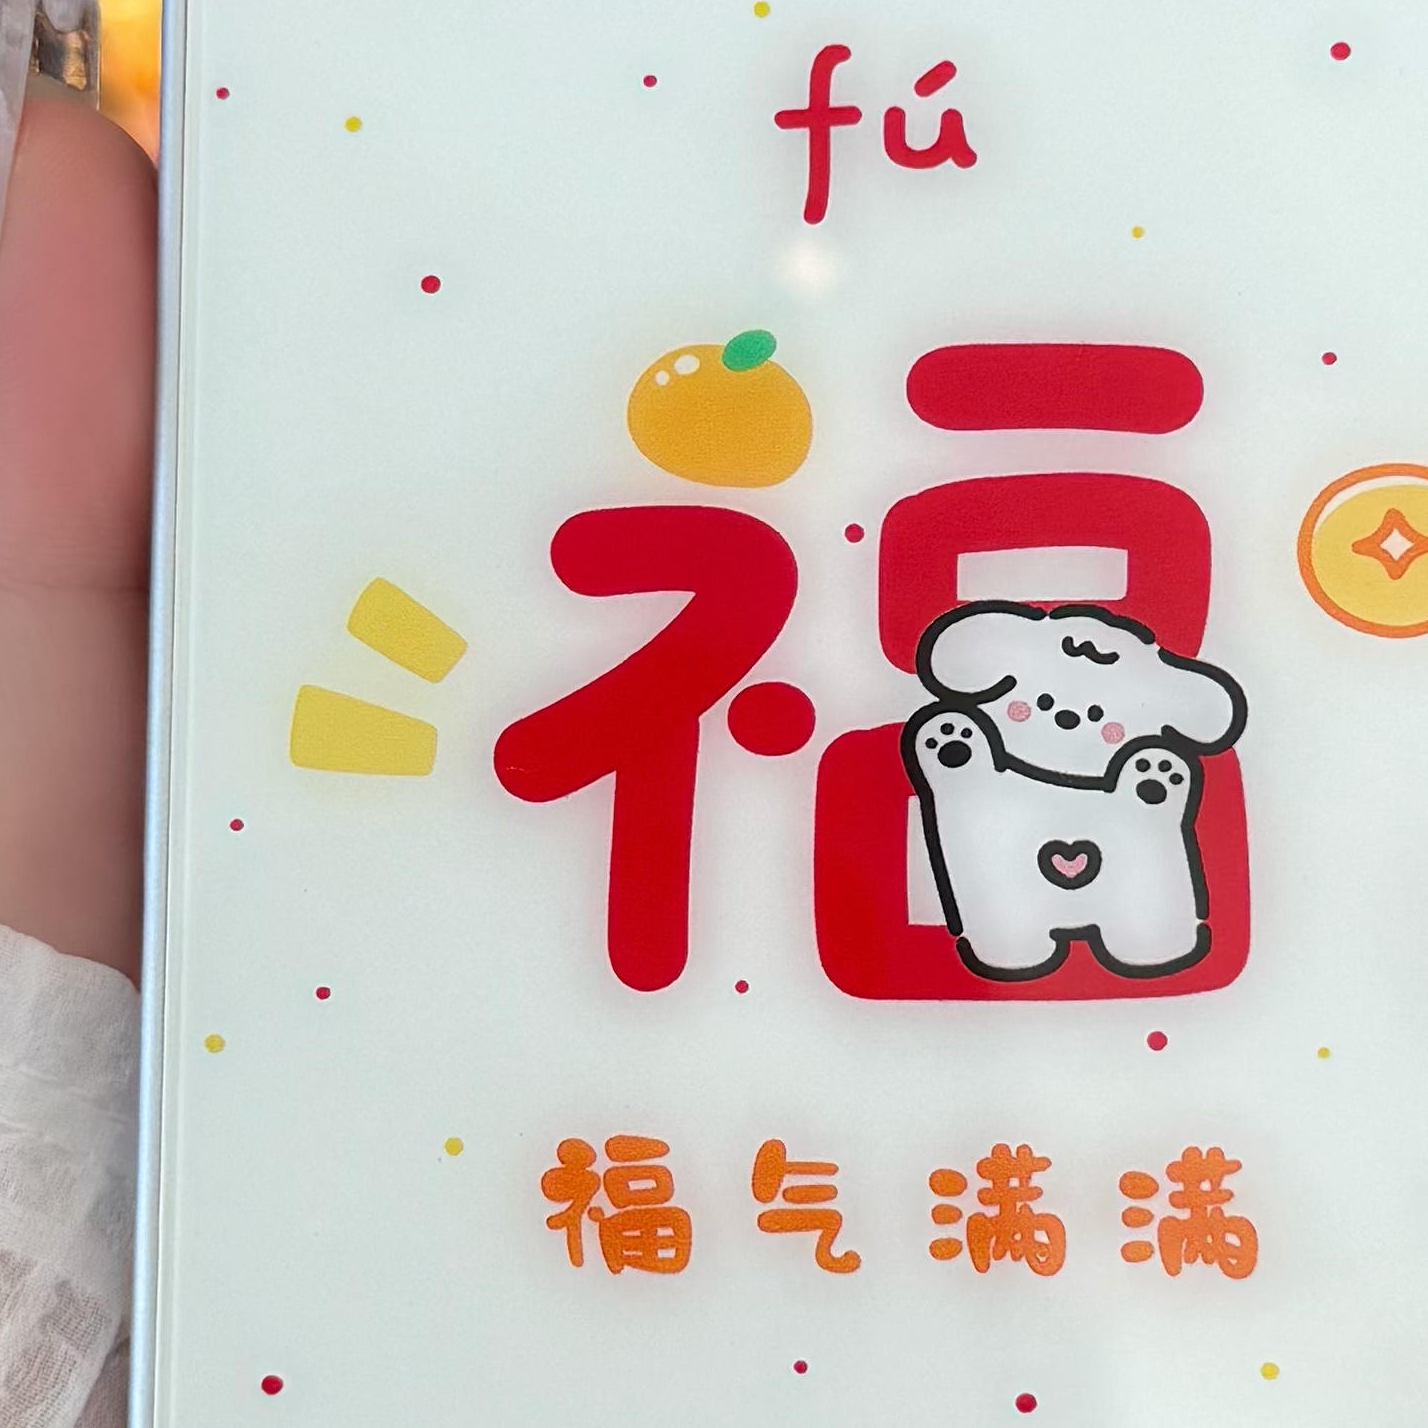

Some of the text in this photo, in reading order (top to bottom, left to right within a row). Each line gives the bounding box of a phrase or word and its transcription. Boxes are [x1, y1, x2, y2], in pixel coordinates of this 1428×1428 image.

[774, 43, 978, 226] fú
[492, 341, 1252, 1003] 福
[539, 1133, 1260, 1281] 福气满满
